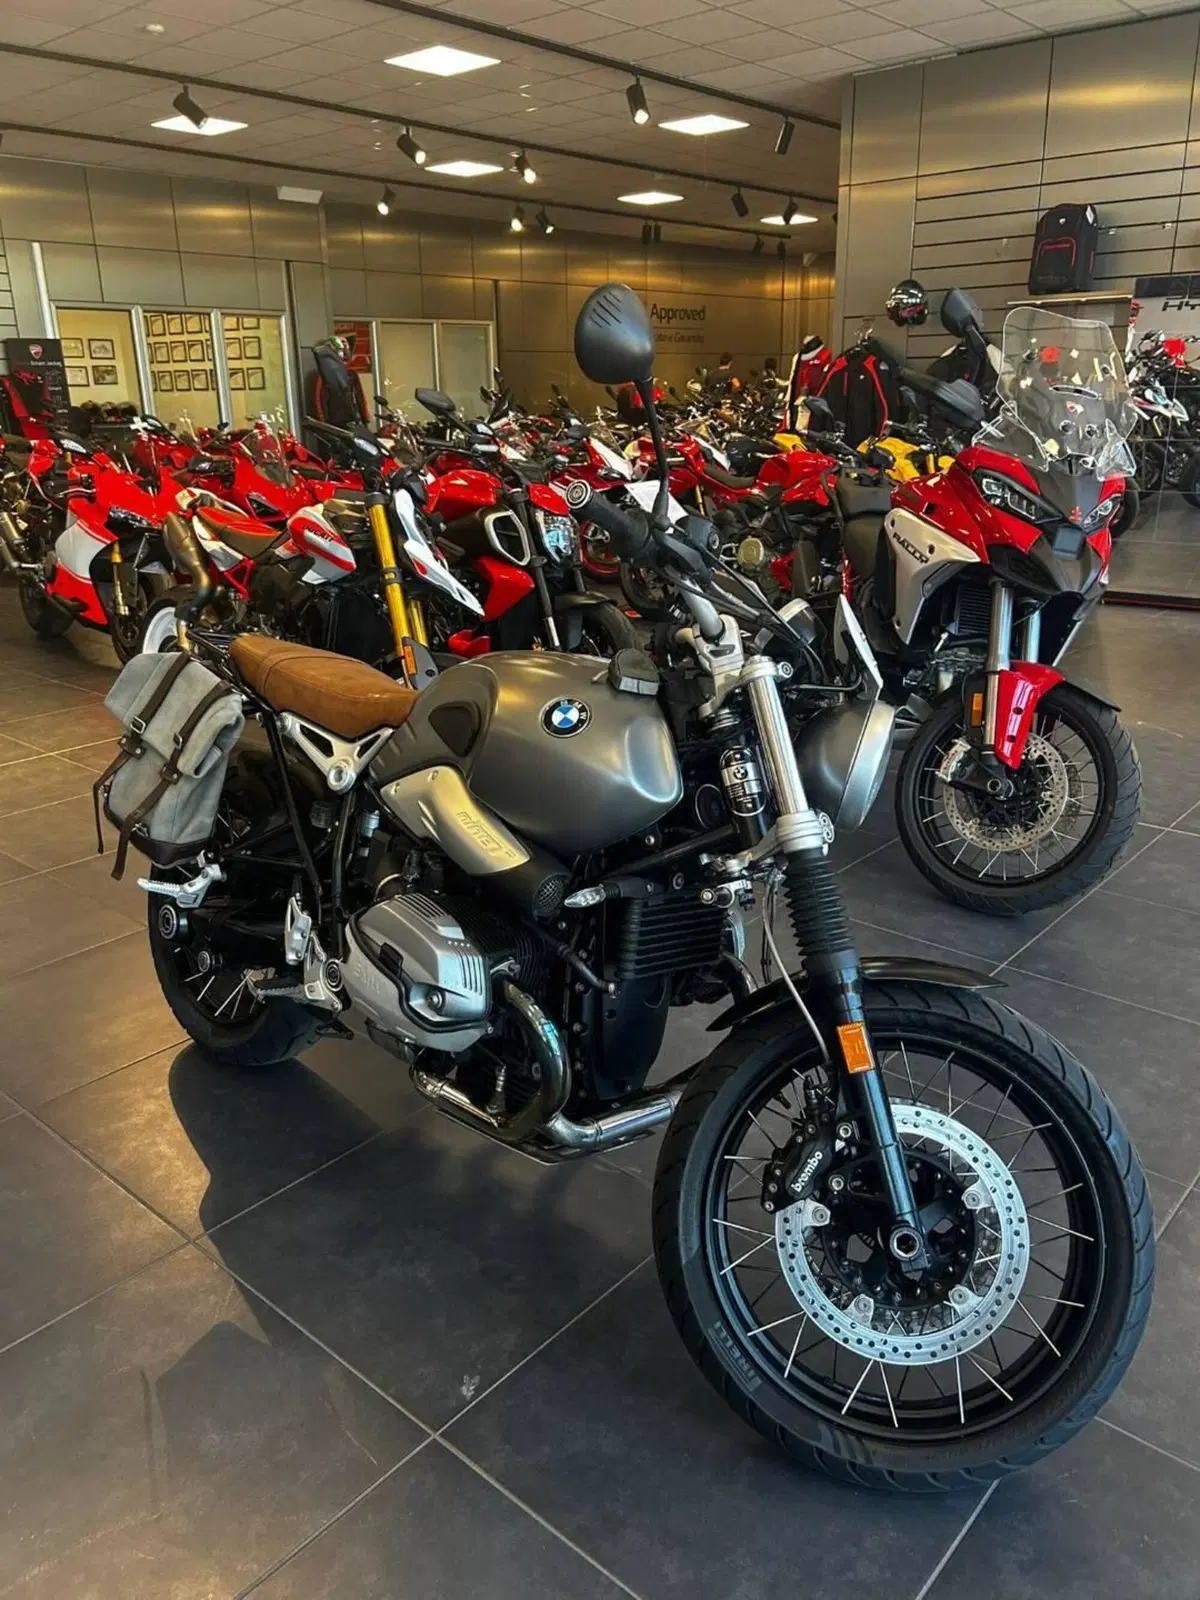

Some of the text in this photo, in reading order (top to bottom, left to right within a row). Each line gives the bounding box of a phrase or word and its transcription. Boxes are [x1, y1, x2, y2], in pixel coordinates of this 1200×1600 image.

[650, 303, 706, 324] Approved
[892, 532, 930, 564] RALLY
[560, 700, 588, 720] BMW
[791, 1151, 823, 1192] brembo
